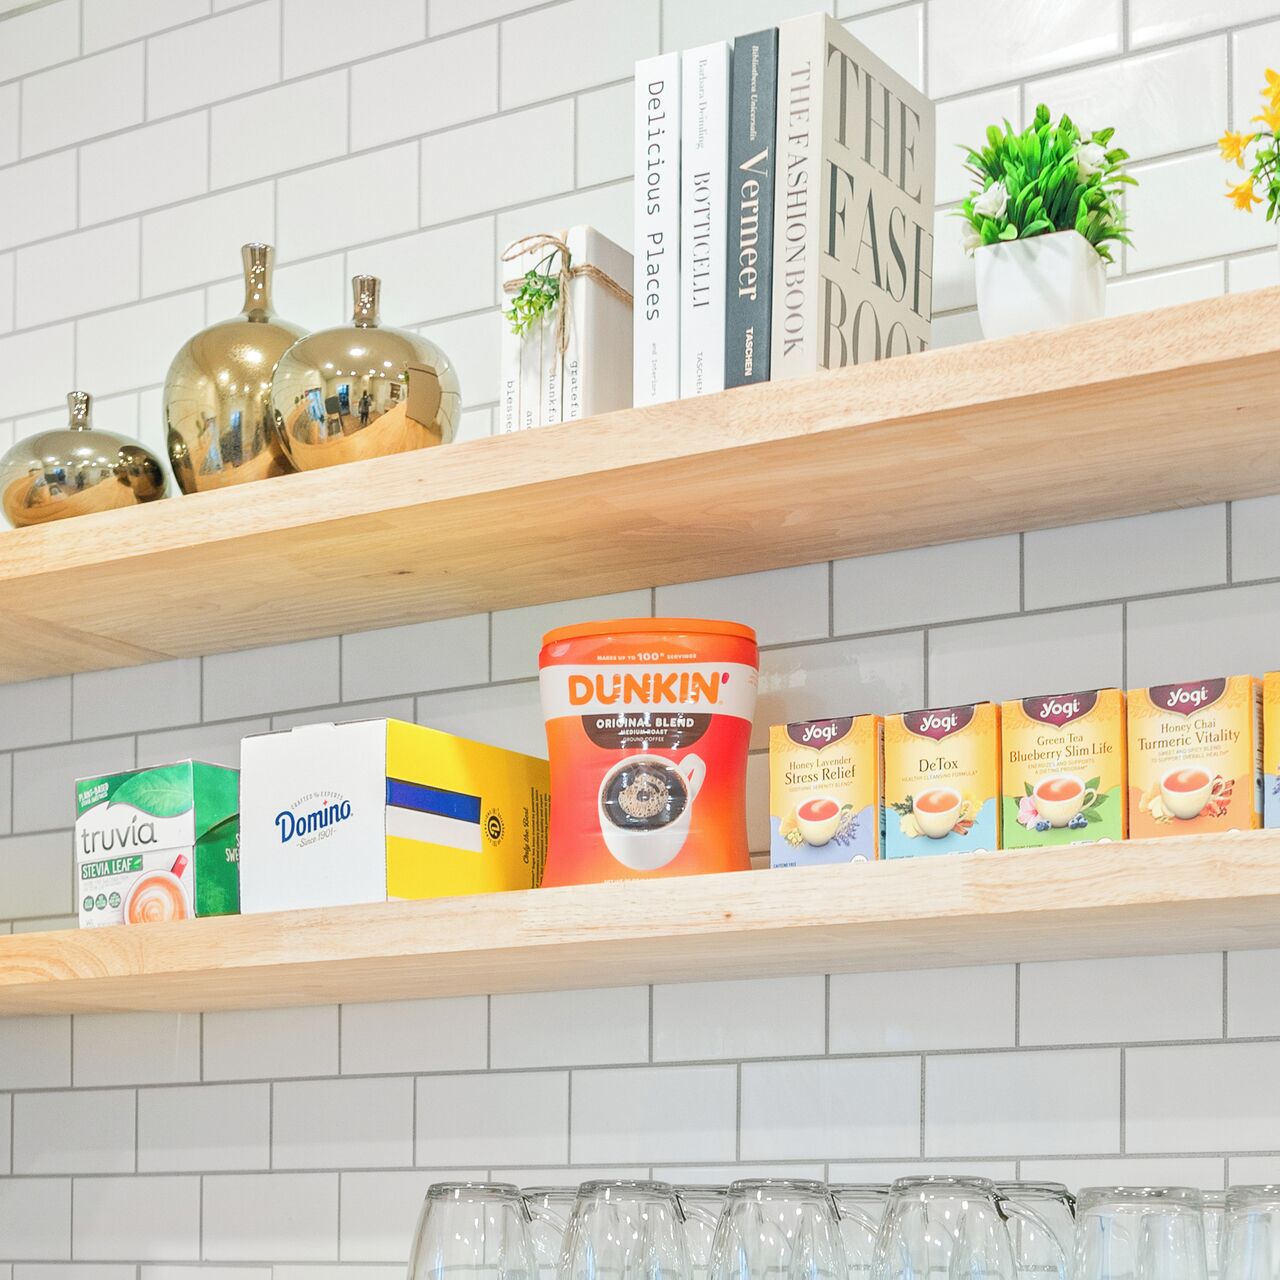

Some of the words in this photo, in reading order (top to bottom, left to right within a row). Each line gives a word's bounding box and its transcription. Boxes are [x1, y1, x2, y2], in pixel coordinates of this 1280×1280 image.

[699, 58, 708, 100] Barbara
[789, 61, 811, 127] THE
[827, 42, 922, 204] THE
[647, 80, 666, 216] Delicious
[785, 132, 809, 263] FASHION
[693, 171, 711, 308] BOTTICELLI
[739, 146, 769, 302] Vermeer
[646, 232, 665, 321] Places
[783, 269, 806, 357] BOOK
[819, 275, 929, 370] BOO
[696, 351, 704, 395] TASCHEN
[745, 326, 754, 377] TASCHEN
[548, 372, 557, 423] hankfu
[569, 360, 580, 417] gratefu
[569, 671, 730, 706] DUNKIN'
[596, 717, 652, 729] ORIGINAL
[655, 718, 695, 728] BLEND
[1037, 735, 1065, 746] Green
[1067, 733, 1084, 743] Tea
[1137, 734, 1192, 751] Turmeric
[1195, 728, 1241, 744] Vitality
[1161, 722, 1192, 733] Honey
[1194, 719, 1216, 730] Chai
[789, 761, 815, 771] Honey
[817, 756, 852, 767] Lavender
[919, 757, 959, 773] DeTox
[1009, 749, 1062, 763] Blueberry
[1065, 745, 1089, 758] Slim
[1092, 742, 1113, 755] Life
[785, 772, 819, 785] Stress
[822, 765, 856, 780] Relief
[275, 799, 351, 843] Domino
[299, 835, 317, 847] Since
[318, 827, 333, 840] 1901
[82, 861, 110, 879] STEVIA
[111, 858, 133, 874] LEAF
[225, 848, 240, 863] SWE
